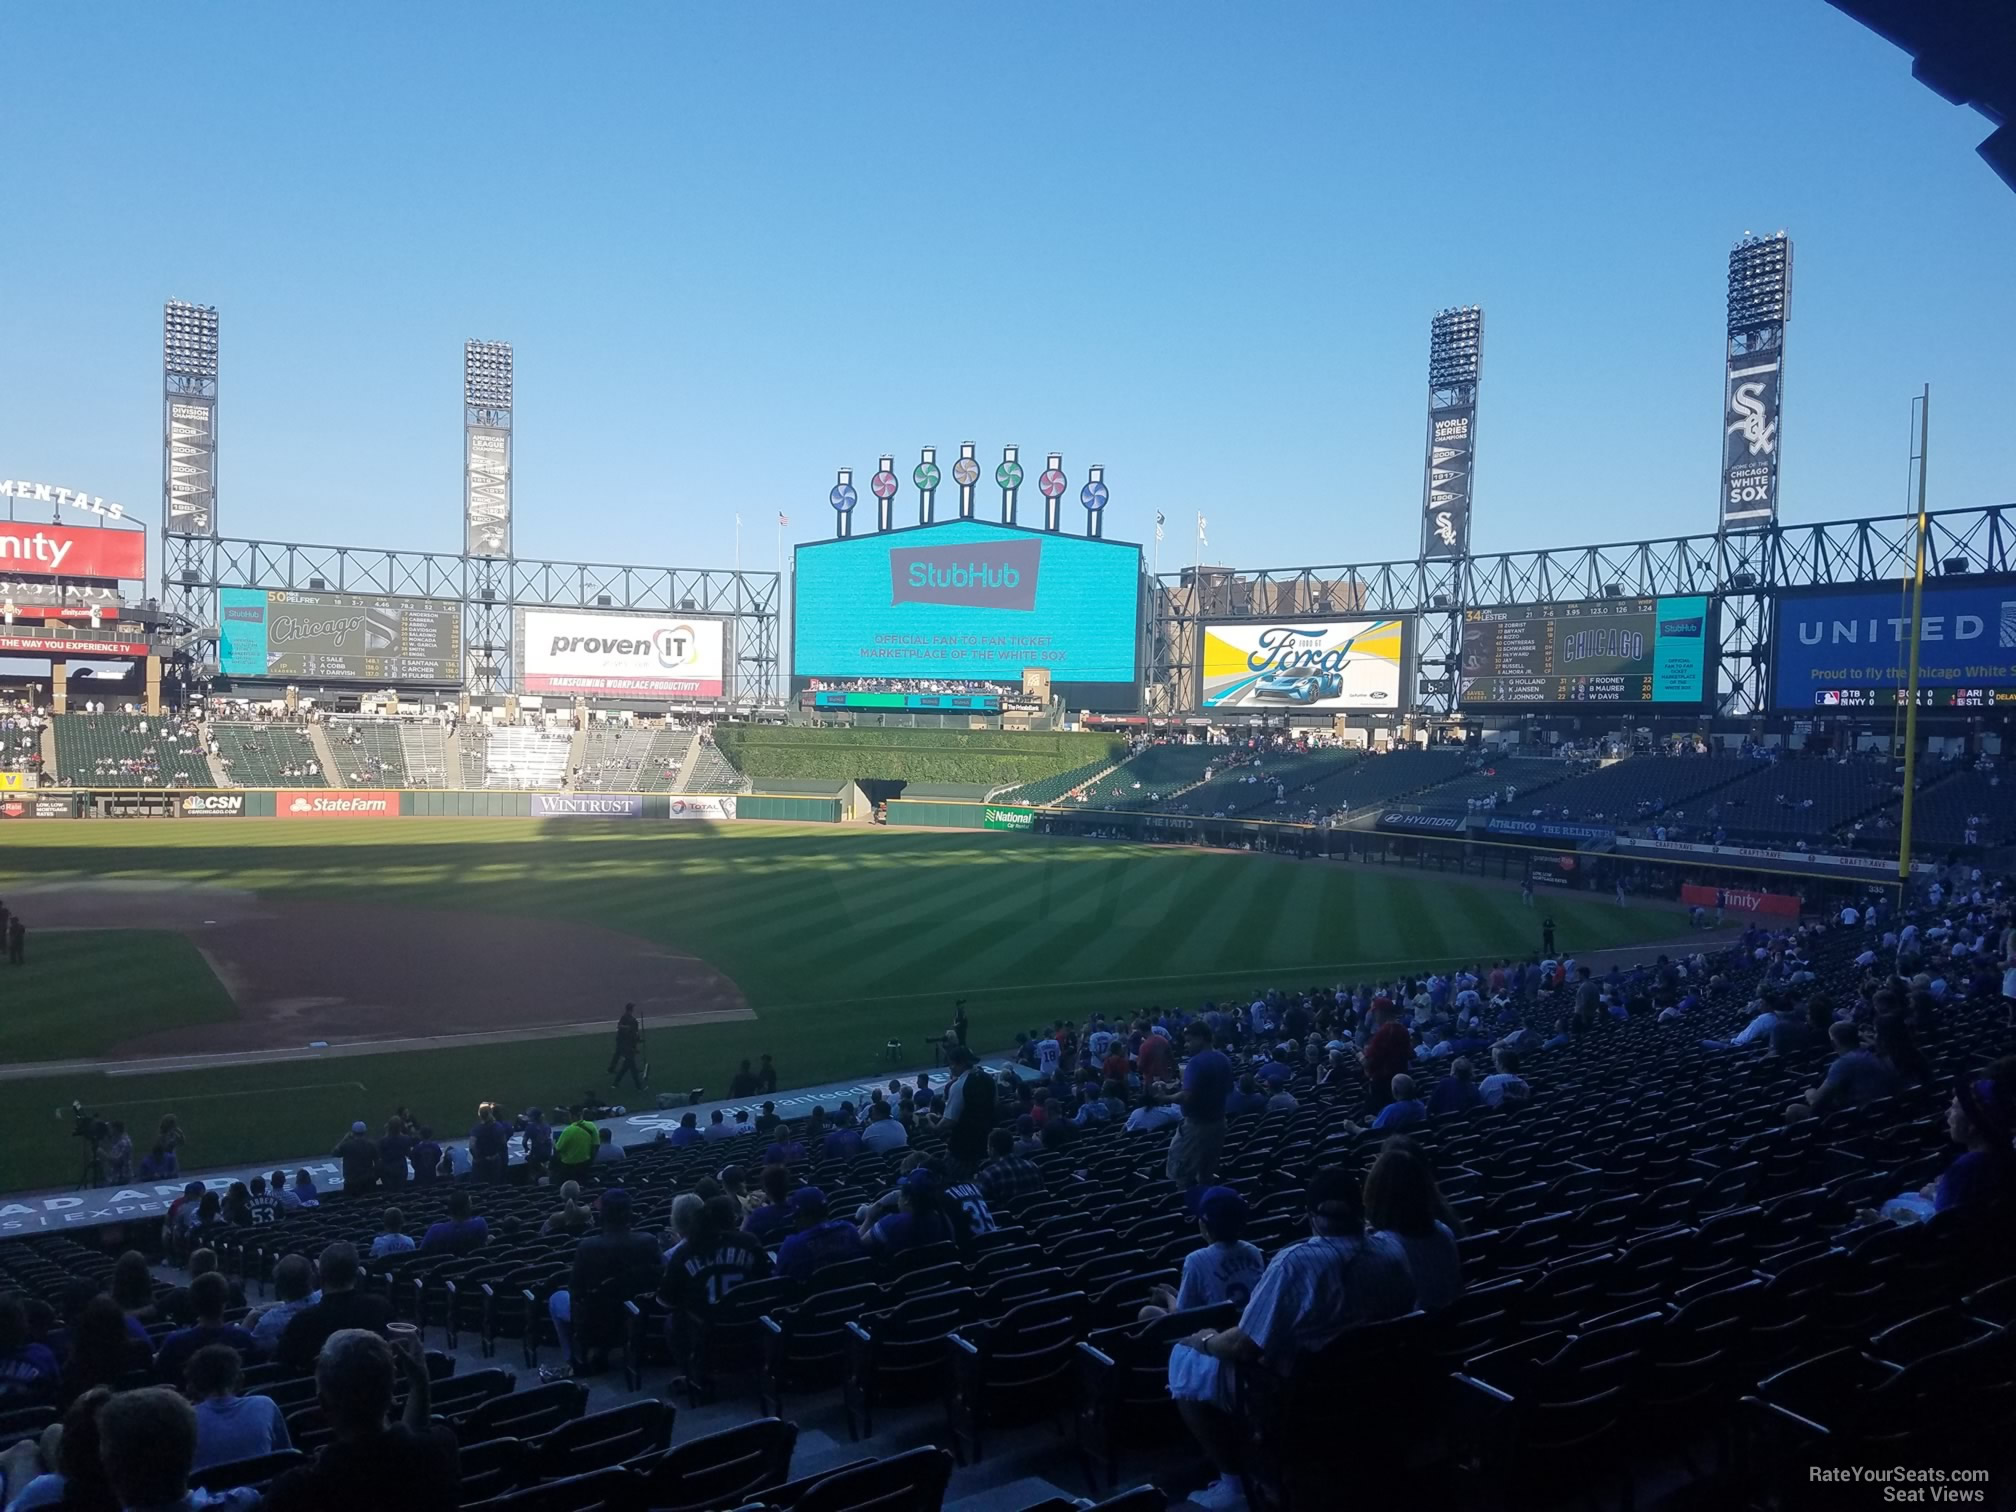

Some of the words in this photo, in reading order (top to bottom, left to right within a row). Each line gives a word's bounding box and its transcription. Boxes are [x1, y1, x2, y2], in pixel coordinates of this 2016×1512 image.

[172, 407, 209, 417] DIVISION
[1435, 418, 1468, 429] WORLD
[1434, 425, 1467, 437] SERIES
[1434, 434, 1467, 442] CHAMPIONS
[472, 440, 505, 449] LEAGUE
[1433, 472, 1454, 480] 1917
[1730, 467, 1769, 479] CHICAGO
[1730, 475, 1769, 488] WHITE
[1730, 485, 1769, 503] SOX
[907, 561, 1020, 588] StubHub
[268, 591, 287, 602] 50
[286, 596, 320, 604] PELFREY
[229, 609, 260, 618] StubHub
[1466, 610, 1481, 621] 34
[1481, 612, 1508, 620] LESTER
[269, 615, 365, 647] Chicago
[1664, 624, 1697, 632] StubHub
[1798, 615, 1985, 645] UNITED
[1, 639, 20, 647] THE
[21, 640, 43, 648] WAY
[44, 641, 65, 649] YOU
[65, 642, 118, 652] EXPERIENCE
[119, 645, 131, 653] TV
[550, 634, 652, 657] proven
[664, 637, 687, 657] IT
[874, 634, 929, 645] OFFICIAL
[932, 635, 958, 646] FAN
[960, 635, 978, 646] TO
[981, 635, 1006, 647] FAN
[1010, 636, 1053, 647] TICKET
[1299, 639, 1313, 648] FORD
[1314, 640, 1322, 648] GT
[1563, 628, 1643, 663] CHICAGO
[860, 648, 949, 659] MARKETPLACE
[951, 649, 969, 660] OF
[971, 649, 995, 660] THE
[998, 650, 1038, 661] WHITE
[1041, 650, 1067, 661] SOX
[1247, 627, 1356, 673] Ford
[1811, 668, 1847, 680] Proud
[1849, 667, 1863, 679] to
[1865, 667, 1883, 681] fly
[1885, 666, 1908, 679] the
[1914, 664, 1962, 680] hicago
[1965, 665, 2007, 677] White
[550, 677, 605, 688] TRANSFORMING
[606, 679, 650, 690] WORKPLACE
[649, 680, 700, 692] PRODUCTIVITY
[1849, 690, 1861, 698] TB
[1869, 689, 1875, 698] 0
[1927, 689, 1934, 698] 0
[1966, 689, 1983, 697] ARI
[1988, 689, 1995, 697] 0
[1848, 698, 1866, 706] NYY
[1869, 698, 1875, 706] 0
[1926, 698, 1933, 706] 0
[1966, 698, 1984, 706] STL
[1988, 698, 1995, 706] 0
[204, 796, 242, 809] CSN
[540, 796, 634, 813] WINTRUST
[688, 802, 719, 810] TOTAL
[994, 811, 1033, 824] National
[1403, 815, 1458, 828] HYUNDAI
[1488, 818, 1537, 832] ATHLETICO
[1541, 824, 1561, 834] THE
[1655, 841, 1673, 849] CRAFT
[1739, 848, 1759, 856] CRAFT
[1839, 857, 1862, 866] CRAFT
[1868, 886, 1885, 894] 335
[1722, 891, 1761, 911] finity
[1043, 1050, 1057, 1063] 18
[108, 1177, 240, 1203] AND
[251, 1208, 275, 1224] 53
